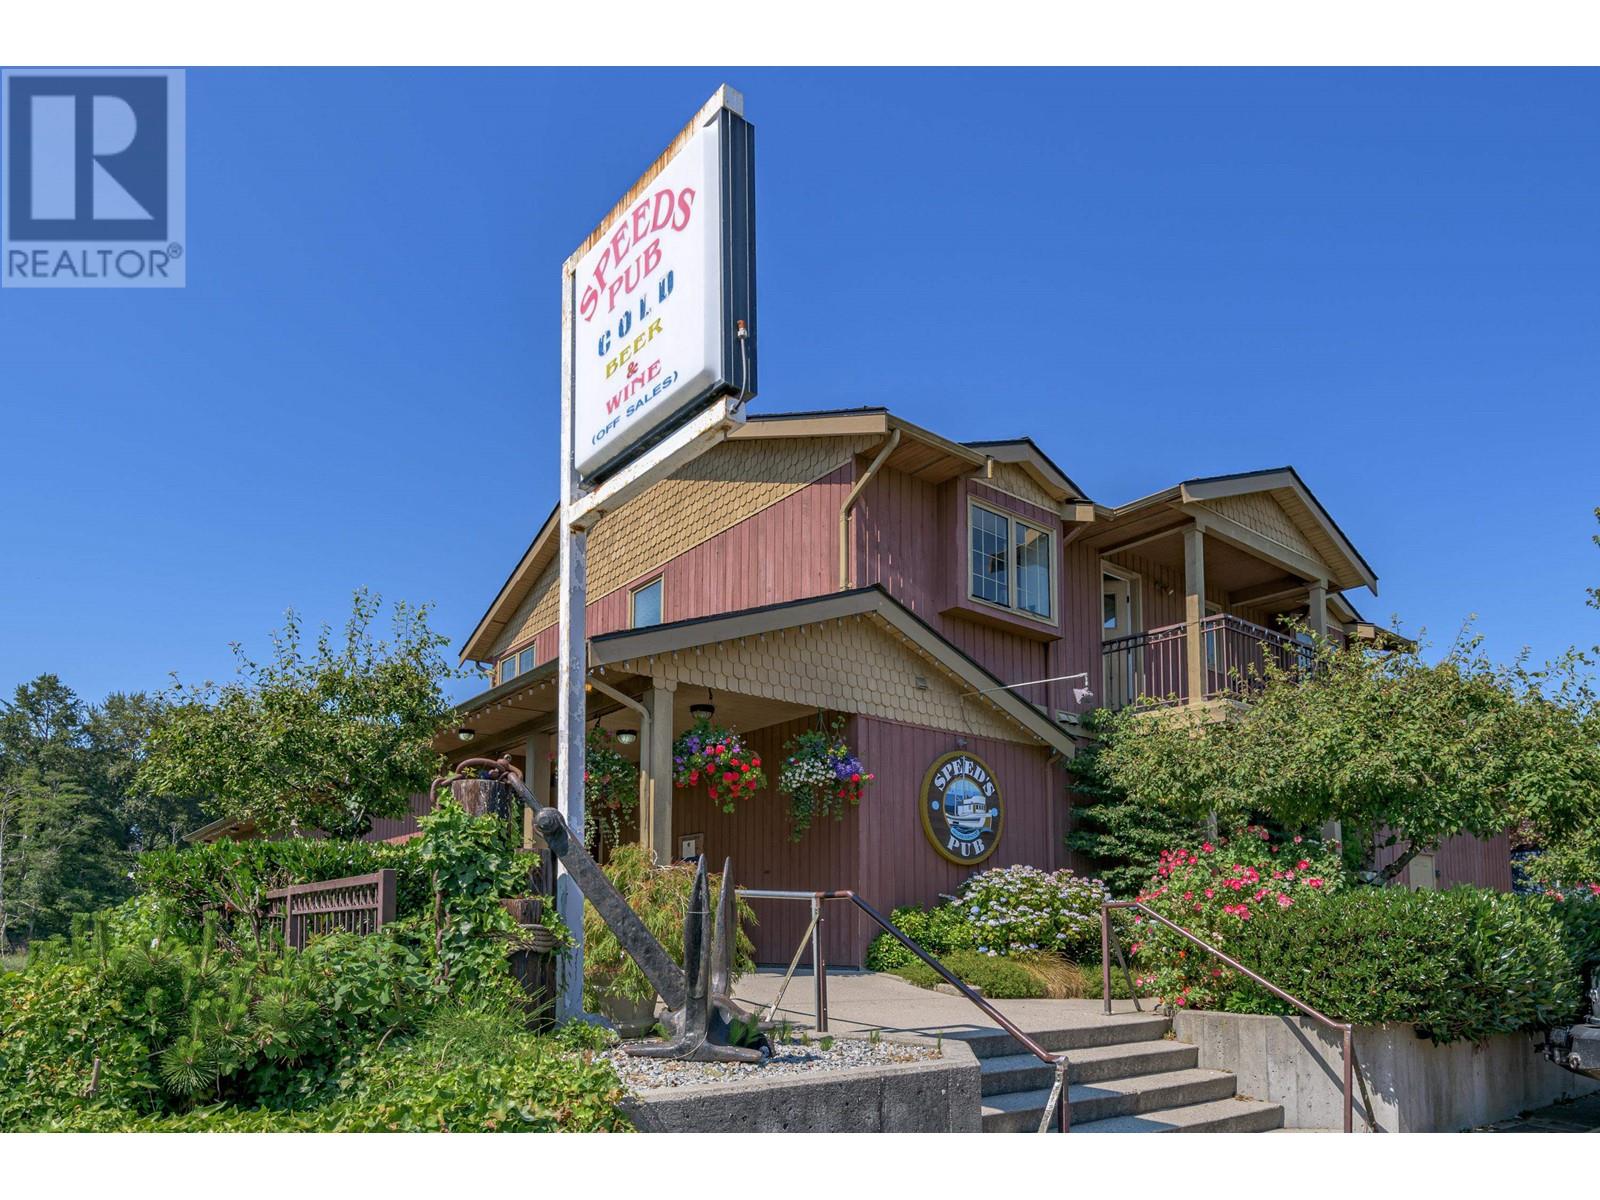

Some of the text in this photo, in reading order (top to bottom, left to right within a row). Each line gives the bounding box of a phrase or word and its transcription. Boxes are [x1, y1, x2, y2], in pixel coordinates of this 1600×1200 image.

[580, 187, 696, 322] SPEEDS
[608, 238, 663, 313] PUB
[597, 269, 674, 357] COLD
[605, 317, 664, 379] BEER
[626, 361, 639, 379] &
[591, 370, 679, 446] (OFF SALES)
[606, 359, 663, 415] WINE
[934, 759, 996, 797] SPEED'S
[947, 836, 985, 857] PUB
